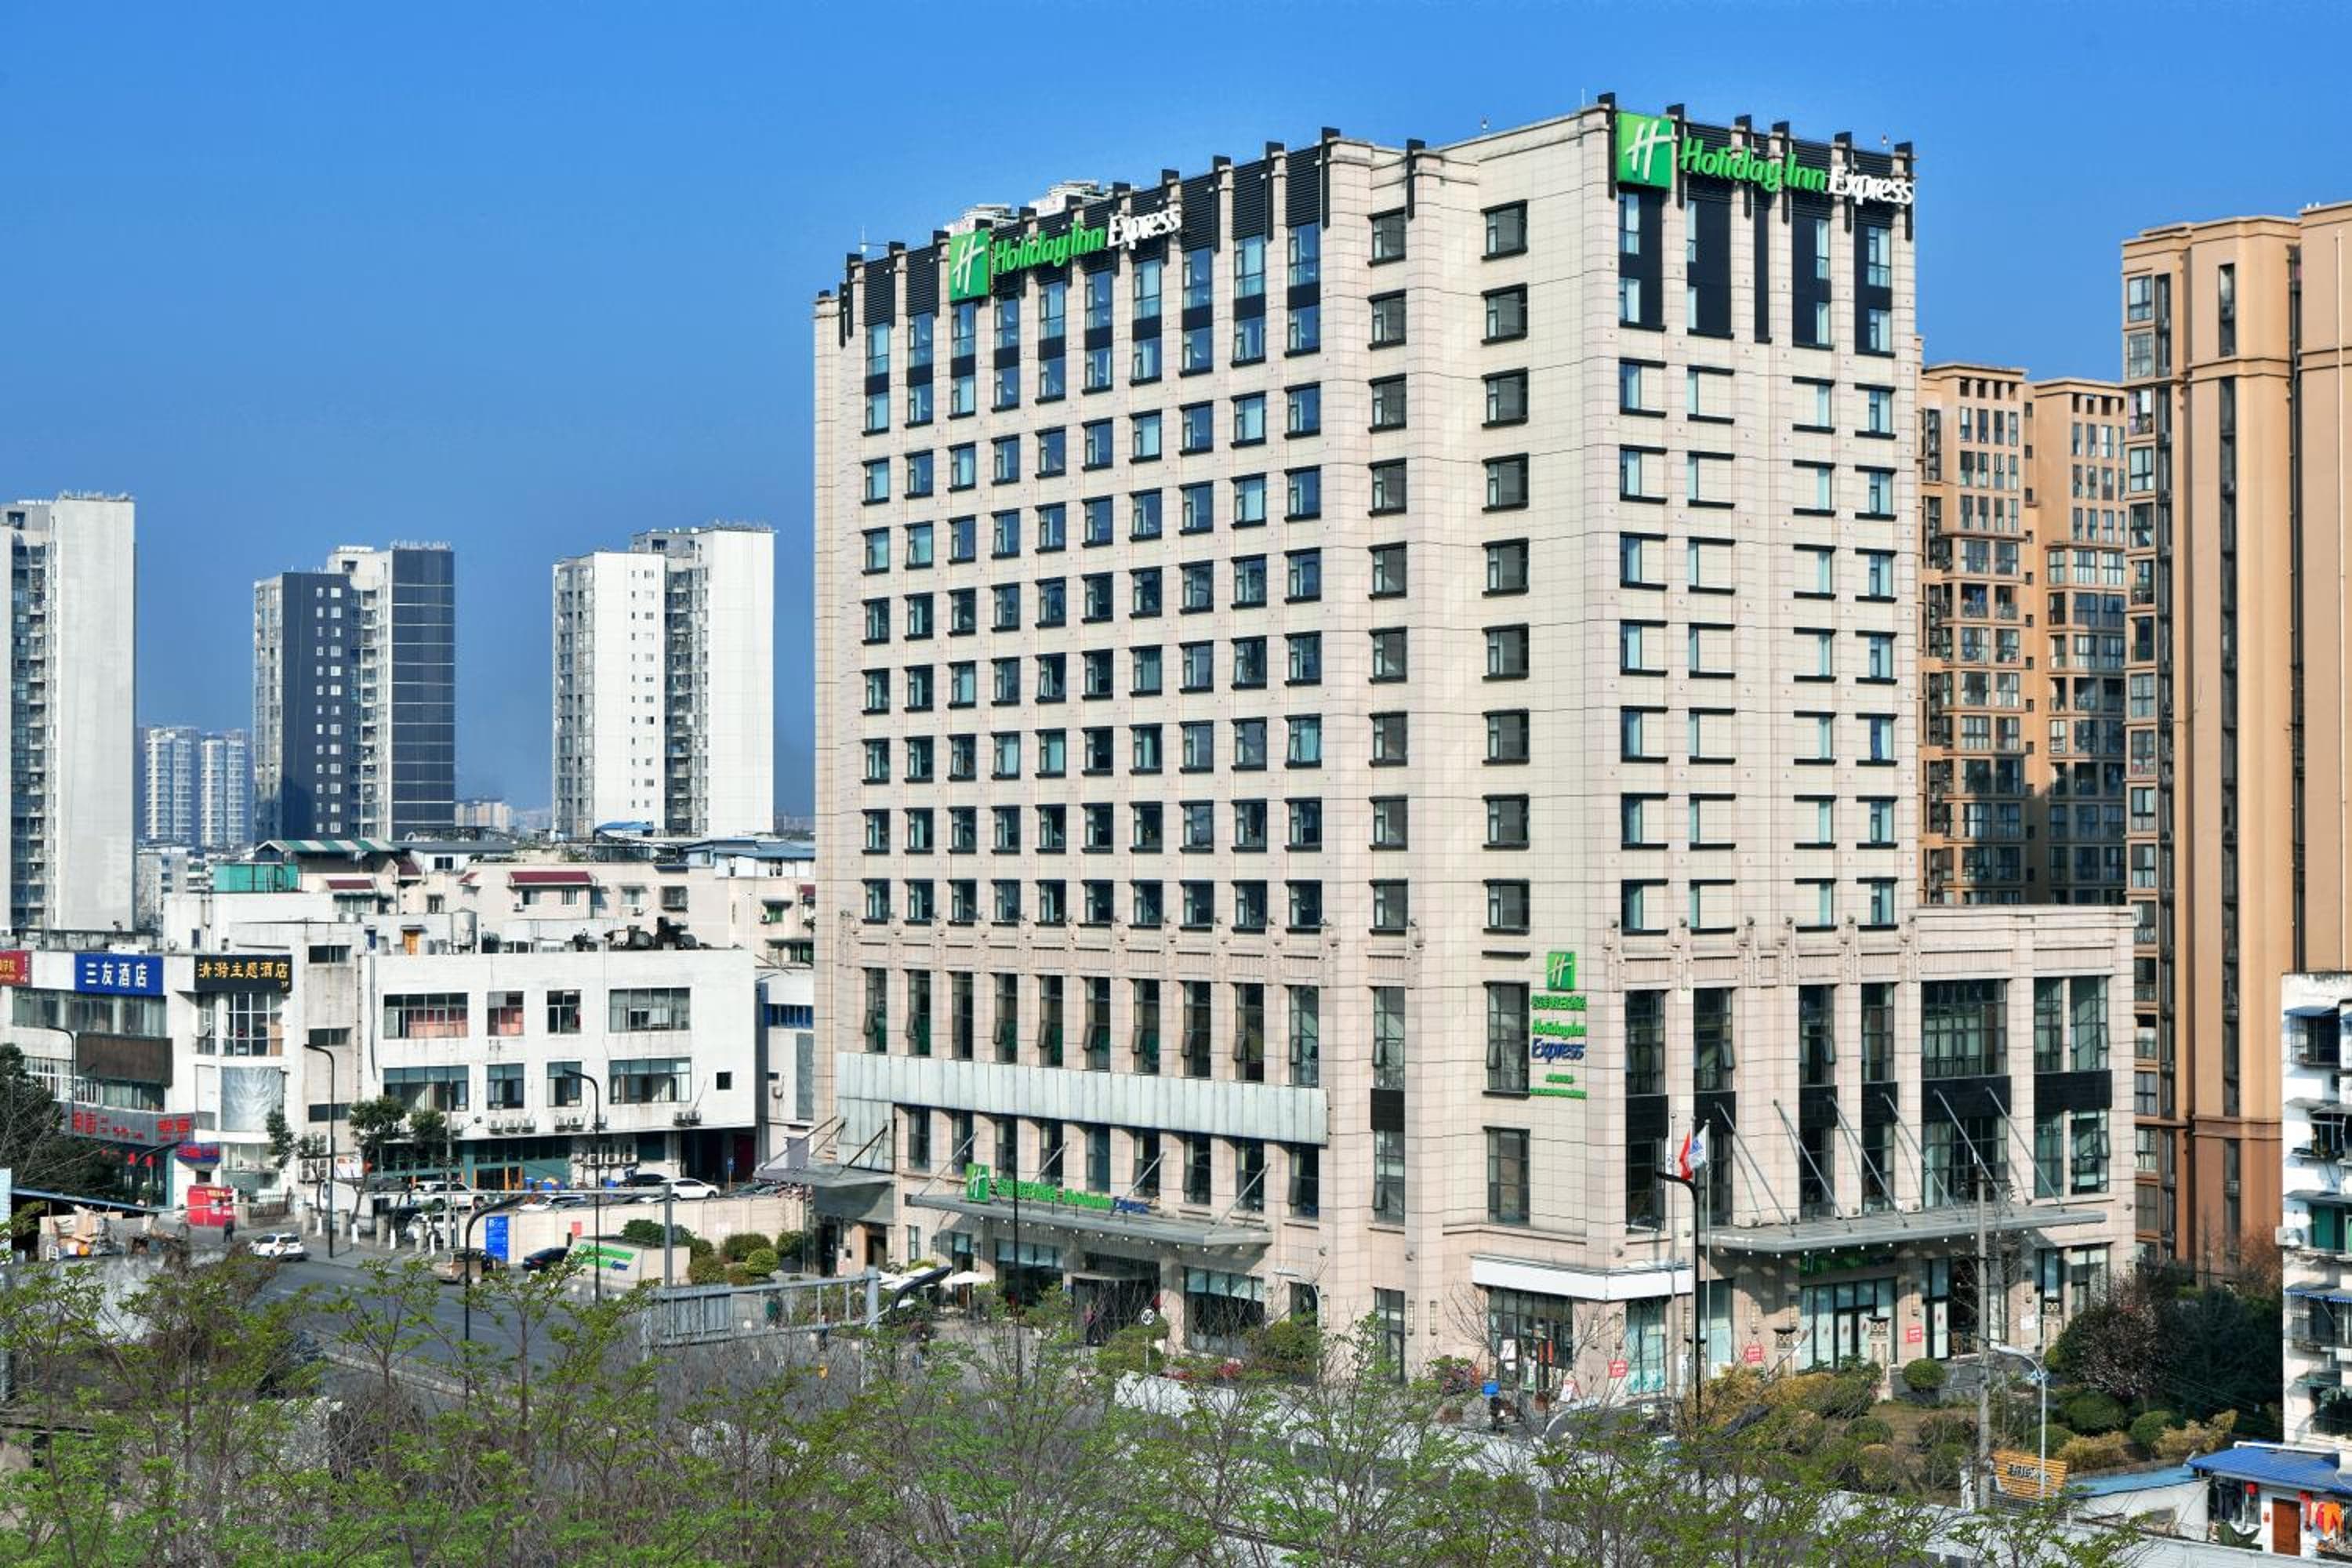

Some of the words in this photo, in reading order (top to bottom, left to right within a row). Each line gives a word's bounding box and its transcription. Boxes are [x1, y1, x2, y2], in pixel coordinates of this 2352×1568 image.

[1679, 136, 1782, 193] Holiday
[1784, 152, 1826, 193] Inn
[1827, 165, 1914, 205] Express
[993, 230, 1070, 275] Holiday
[1069, 223, 1107, 256] Inn
[1107, 209, 1181, 249] Express
[85, 961, 147, 988] 三友酒店
[1531, 1037, 1585, 1063] Express
